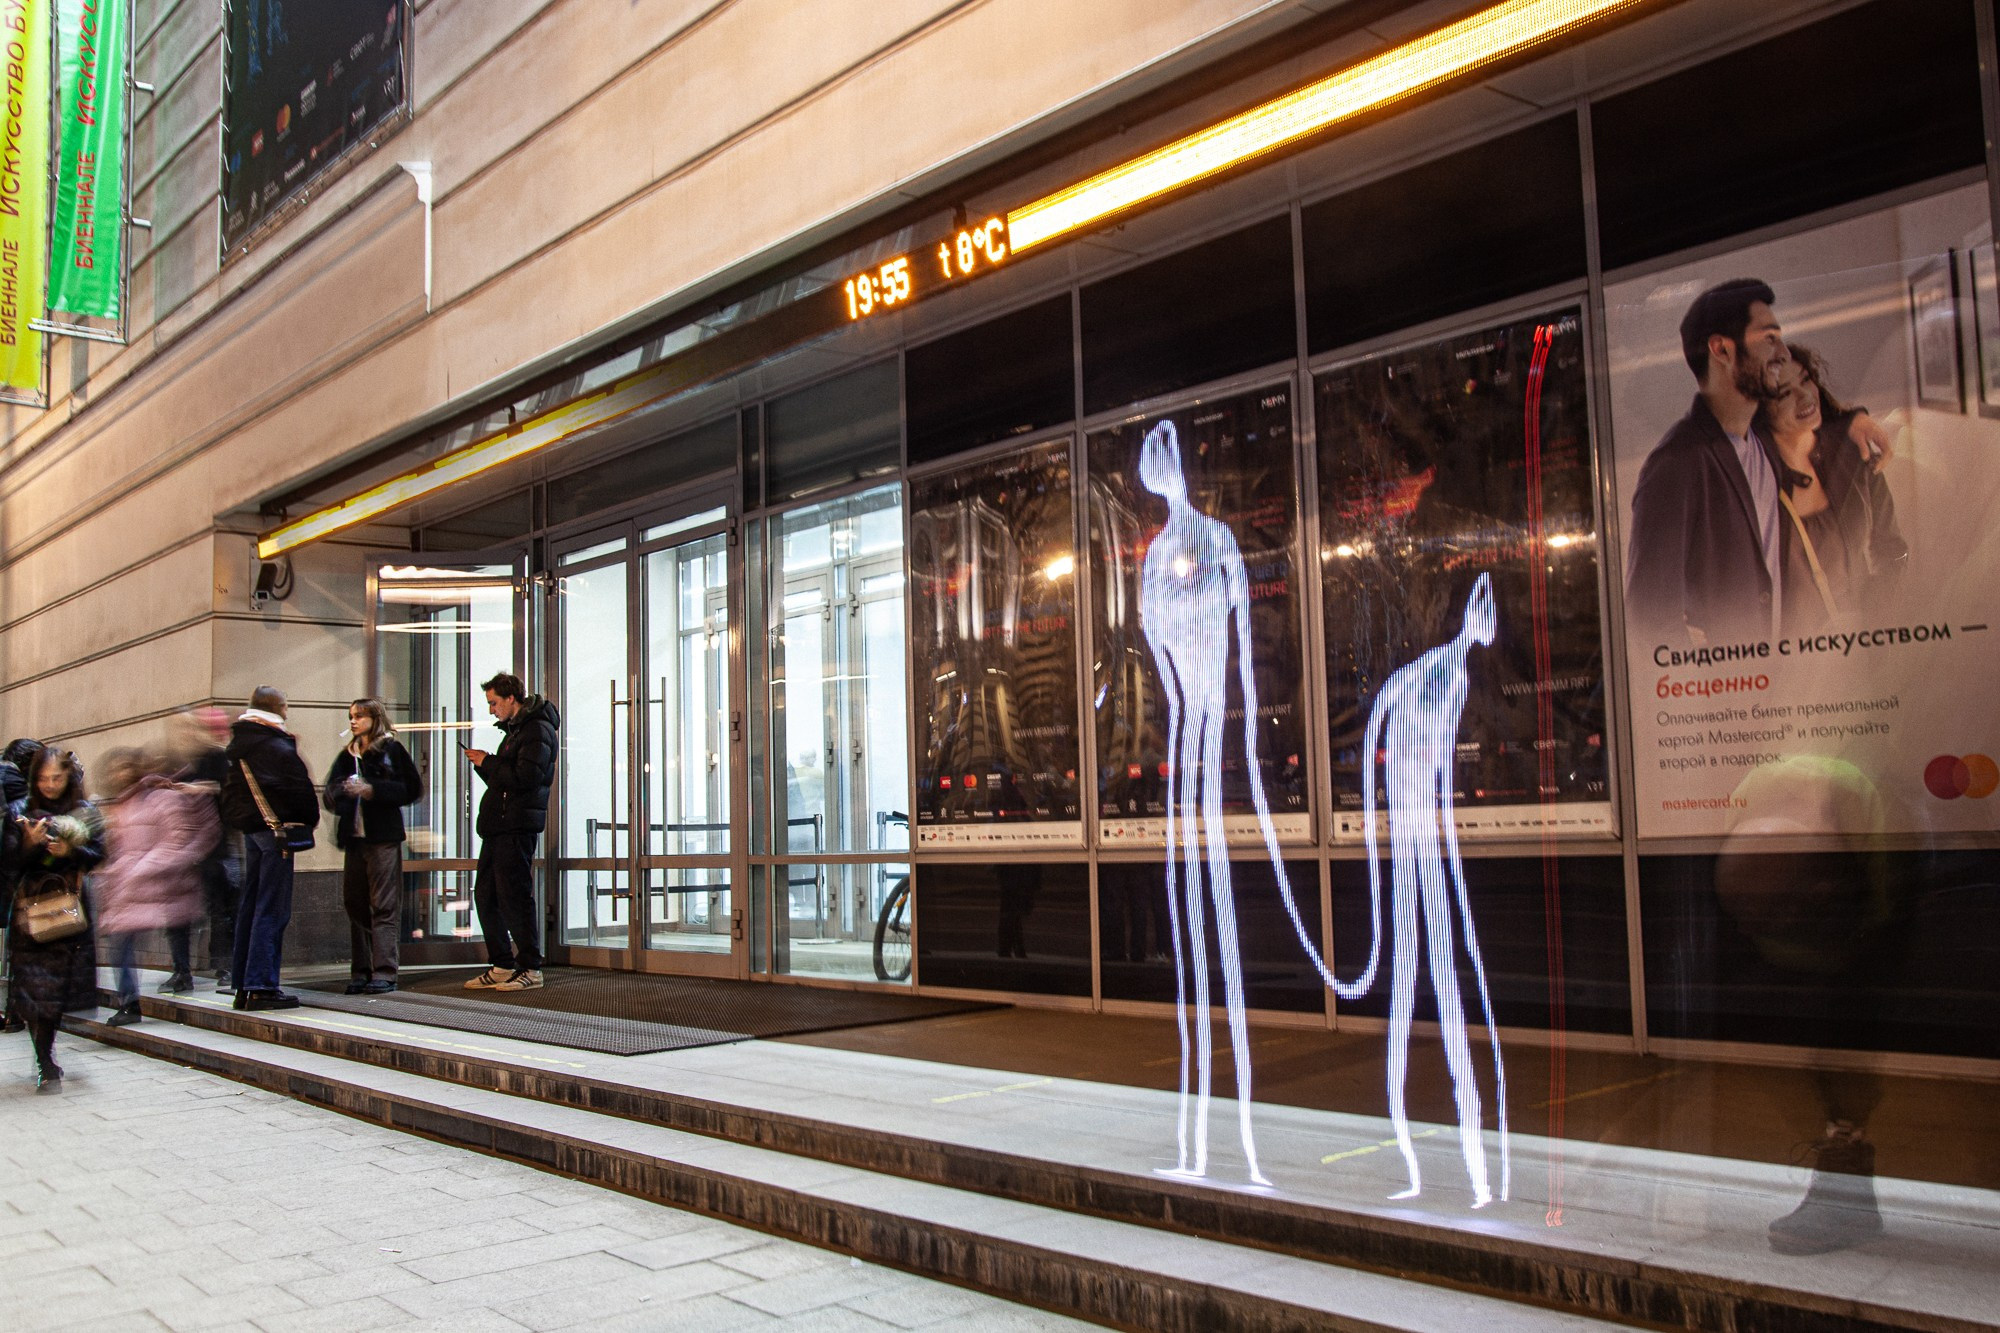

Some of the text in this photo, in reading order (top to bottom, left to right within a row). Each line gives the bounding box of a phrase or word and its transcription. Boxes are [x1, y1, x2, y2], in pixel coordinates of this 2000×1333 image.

[0, 41, 26, 217] ИСКУССТВО
[75, 149, 95, 269] БИЕННАЛЕ
[1, 238, 18, 346] БИЕННАЛЕ
[845, 257, 911, 320] 19:55
[1249, 579, 1287, 600] UTURE
[1654, 641, 1770, 668] Свидание
[1779, 638, 1791, 655] с
[1799, 622, 1951, 657] искусством
[1656, 674, 1769, 699] бесценно
[1657, 695, 1899, 727] Оплачивайте билет премиальной
[1658, 731, 1705, 750] картой
[1797, 727, 1807, 739] и
[1811, 720, 1890, 740] получайте
[1659, 755, 1706, 772] второй
[1710, 755, 1718, 767] в
[1662, 793, 1748, 811] mastercard.ru
